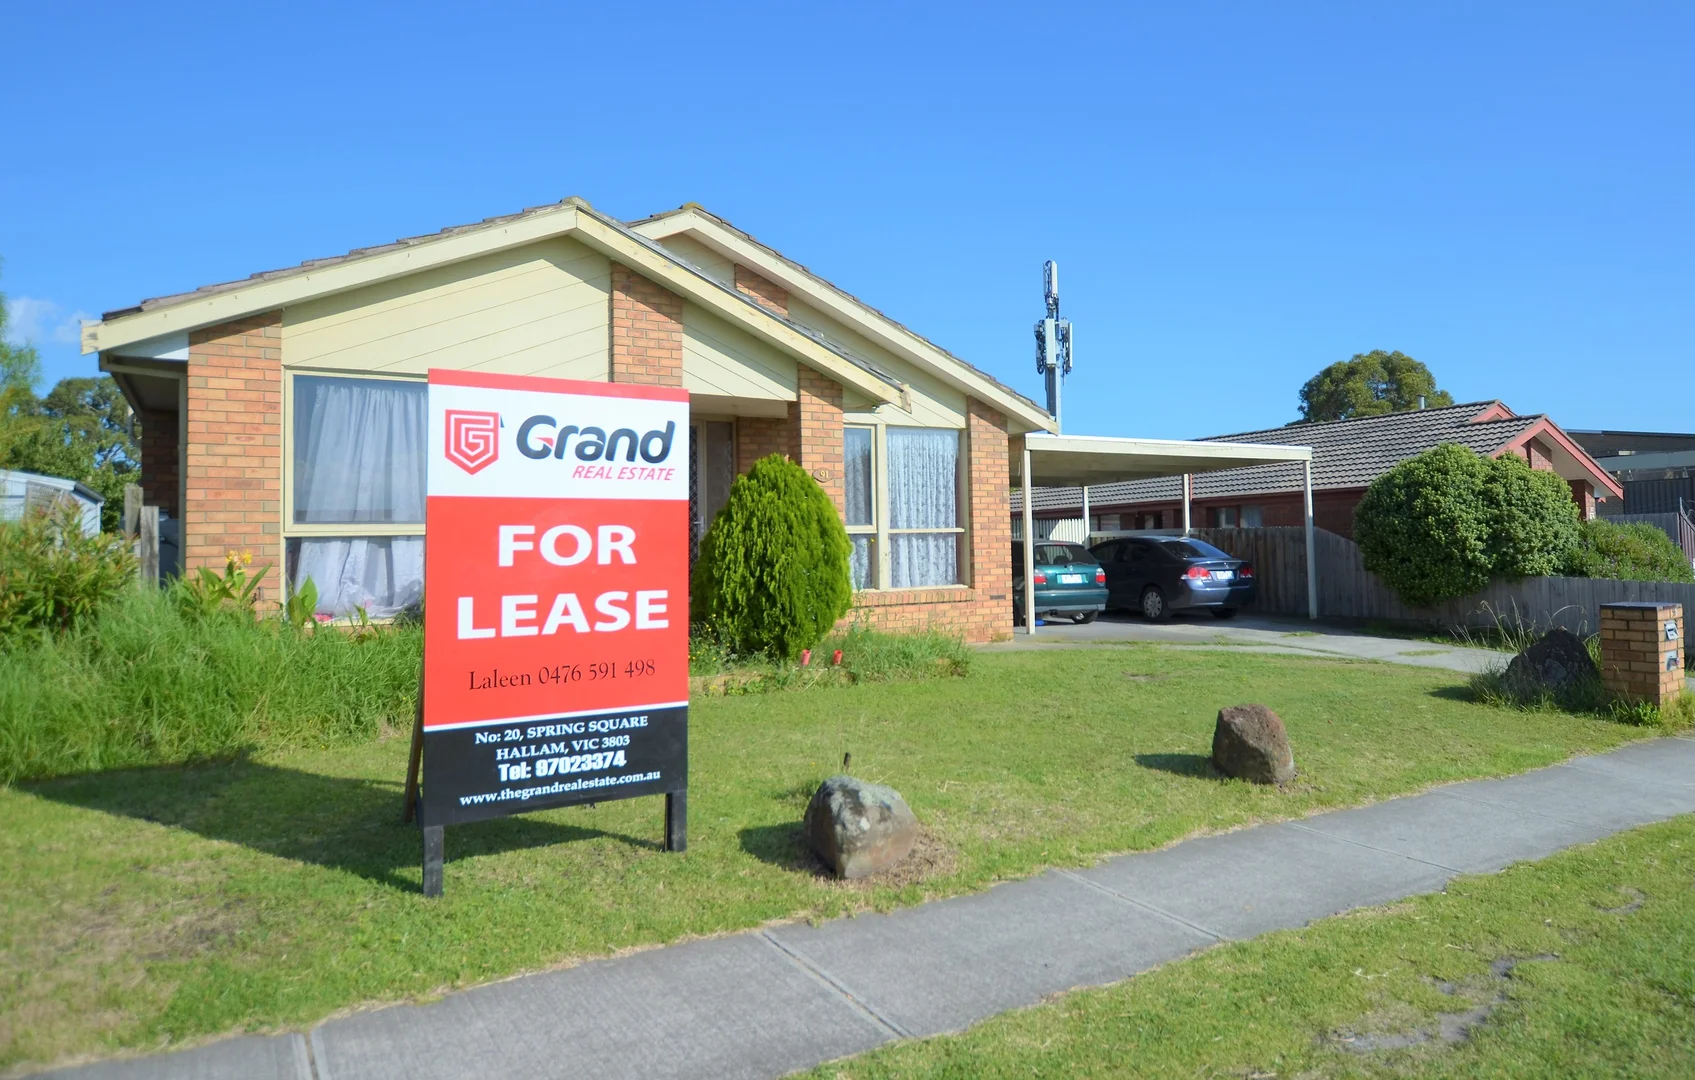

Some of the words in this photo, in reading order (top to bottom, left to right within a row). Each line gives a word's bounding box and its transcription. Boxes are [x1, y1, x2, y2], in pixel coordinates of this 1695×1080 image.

[516, 415, 676, 464] Grand
[572, 465, 613, 479] REAL
[617, 466, 675, 481] ESTATE
[820, 470, 829, 479] 91
[498, 524, 637, 567] FOR
[457, 590, 669, 640] LEASE
[469, 669, 532, 690] Laleen
[538, 664, 582, 685] 0476
[589, 661, 617, 680] 591
[624, 659, 656, 678] 498
[475, 731, 501, 745] No:
[504, 729, 524, 742] 20,
[527, 721, 585, 739] SPRING
[588, 716, 649, 733] SQUARE
[496, 742, 569, 761] HALLAM,
[572, 737, 599, 752] VIC
[601, 735, 631, 748] 3803
[498, 761, 532, 782] Tel:
[460, 770, 662, 806] www.thegrandrealestate.com.au
